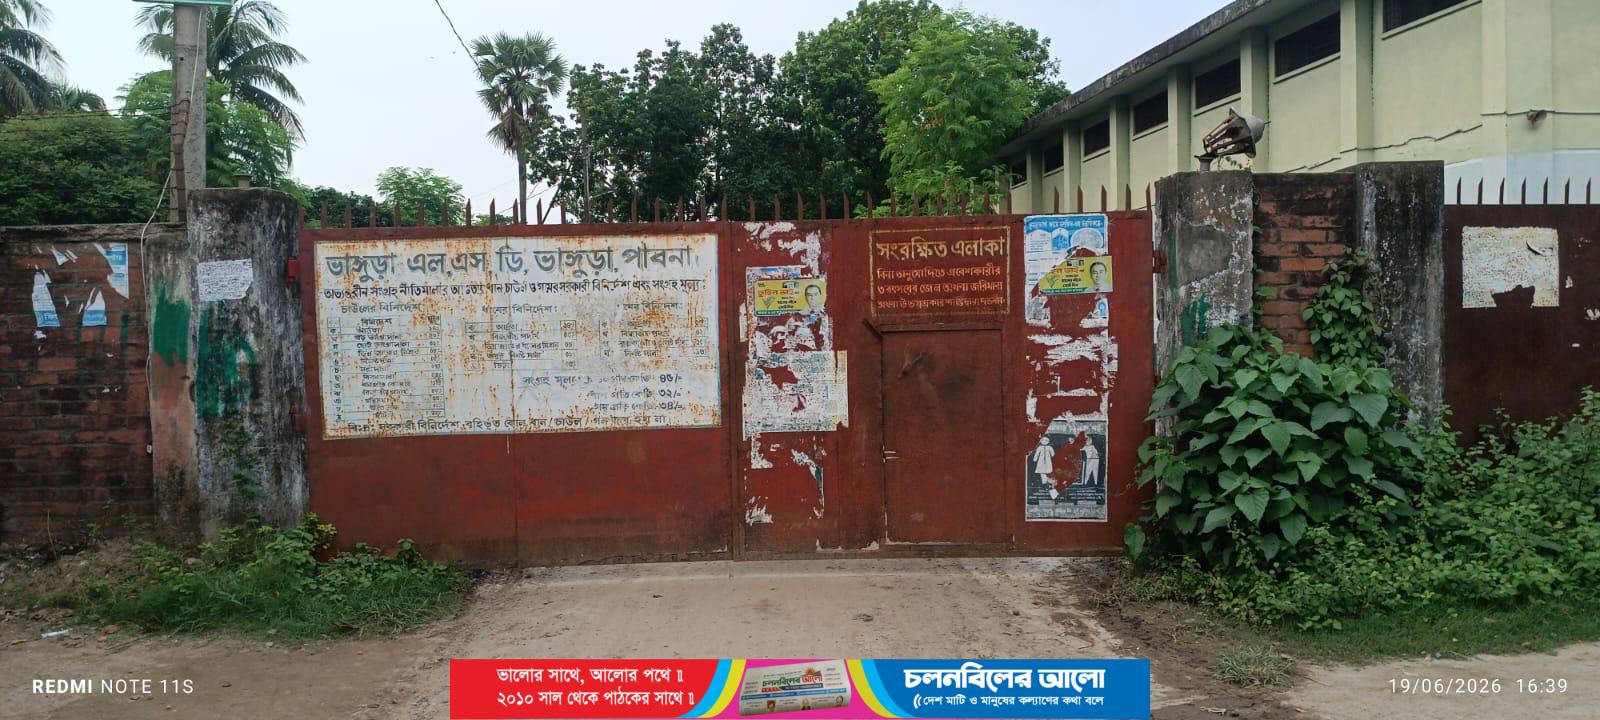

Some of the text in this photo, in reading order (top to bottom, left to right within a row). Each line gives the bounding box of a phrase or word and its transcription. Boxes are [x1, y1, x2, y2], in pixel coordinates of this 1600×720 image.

[876, 236, 947, 260] সংরক্ষিত
[951, 236, 1005, 257] এলাকা
[325, 252, 397, 283] ভাঙ্গুড়া
[877, 267, 894, 280] বিনা
[529, 283, 536, 294] ও
[341, 302, 376, 314] চাউলের
